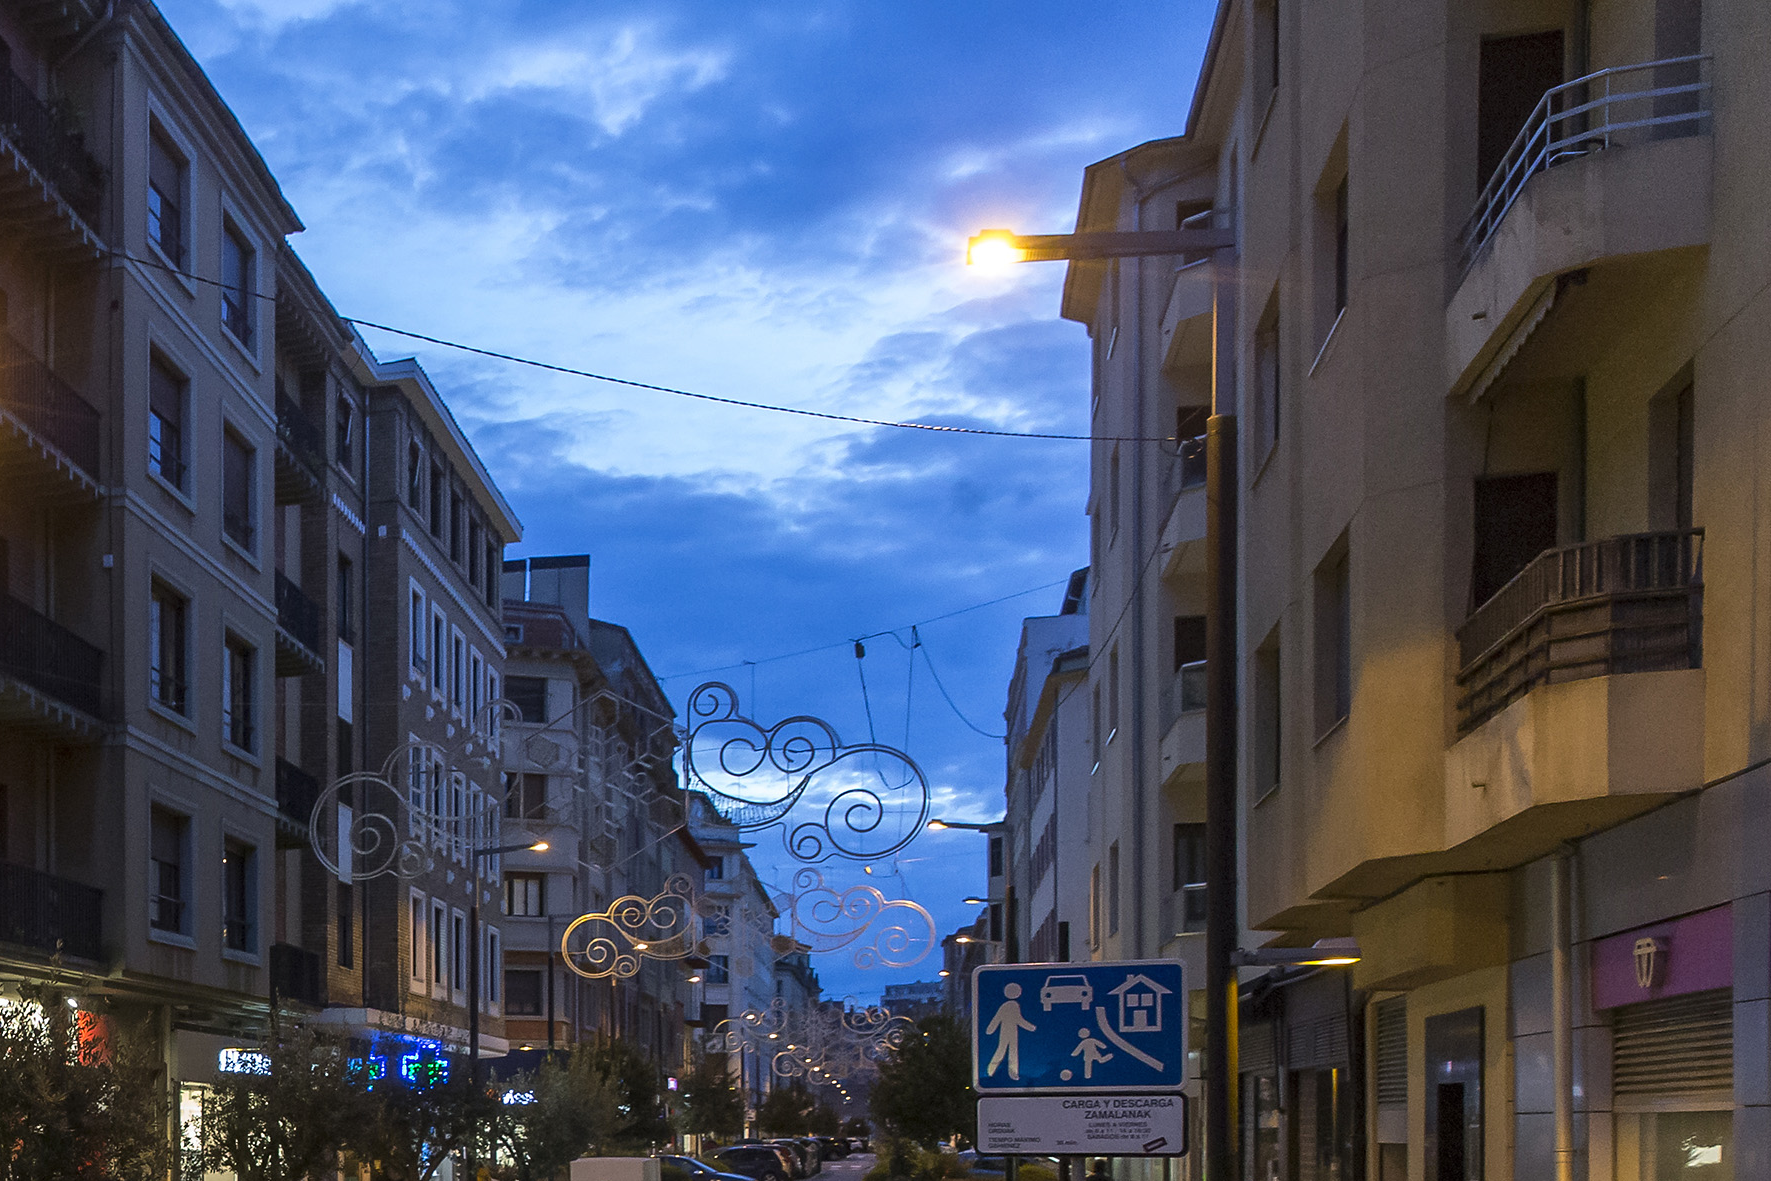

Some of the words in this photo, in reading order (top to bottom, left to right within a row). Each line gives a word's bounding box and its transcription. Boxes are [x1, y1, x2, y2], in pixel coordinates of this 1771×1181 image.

[1062, 1099, 1101, 1109] CARGA
[1104, 1099, 1112, 1108] Y
[1113, 1098, 1174, 1108] DESCARGA
[1084, 1110, 1152, 1119] ZAMALANAK
